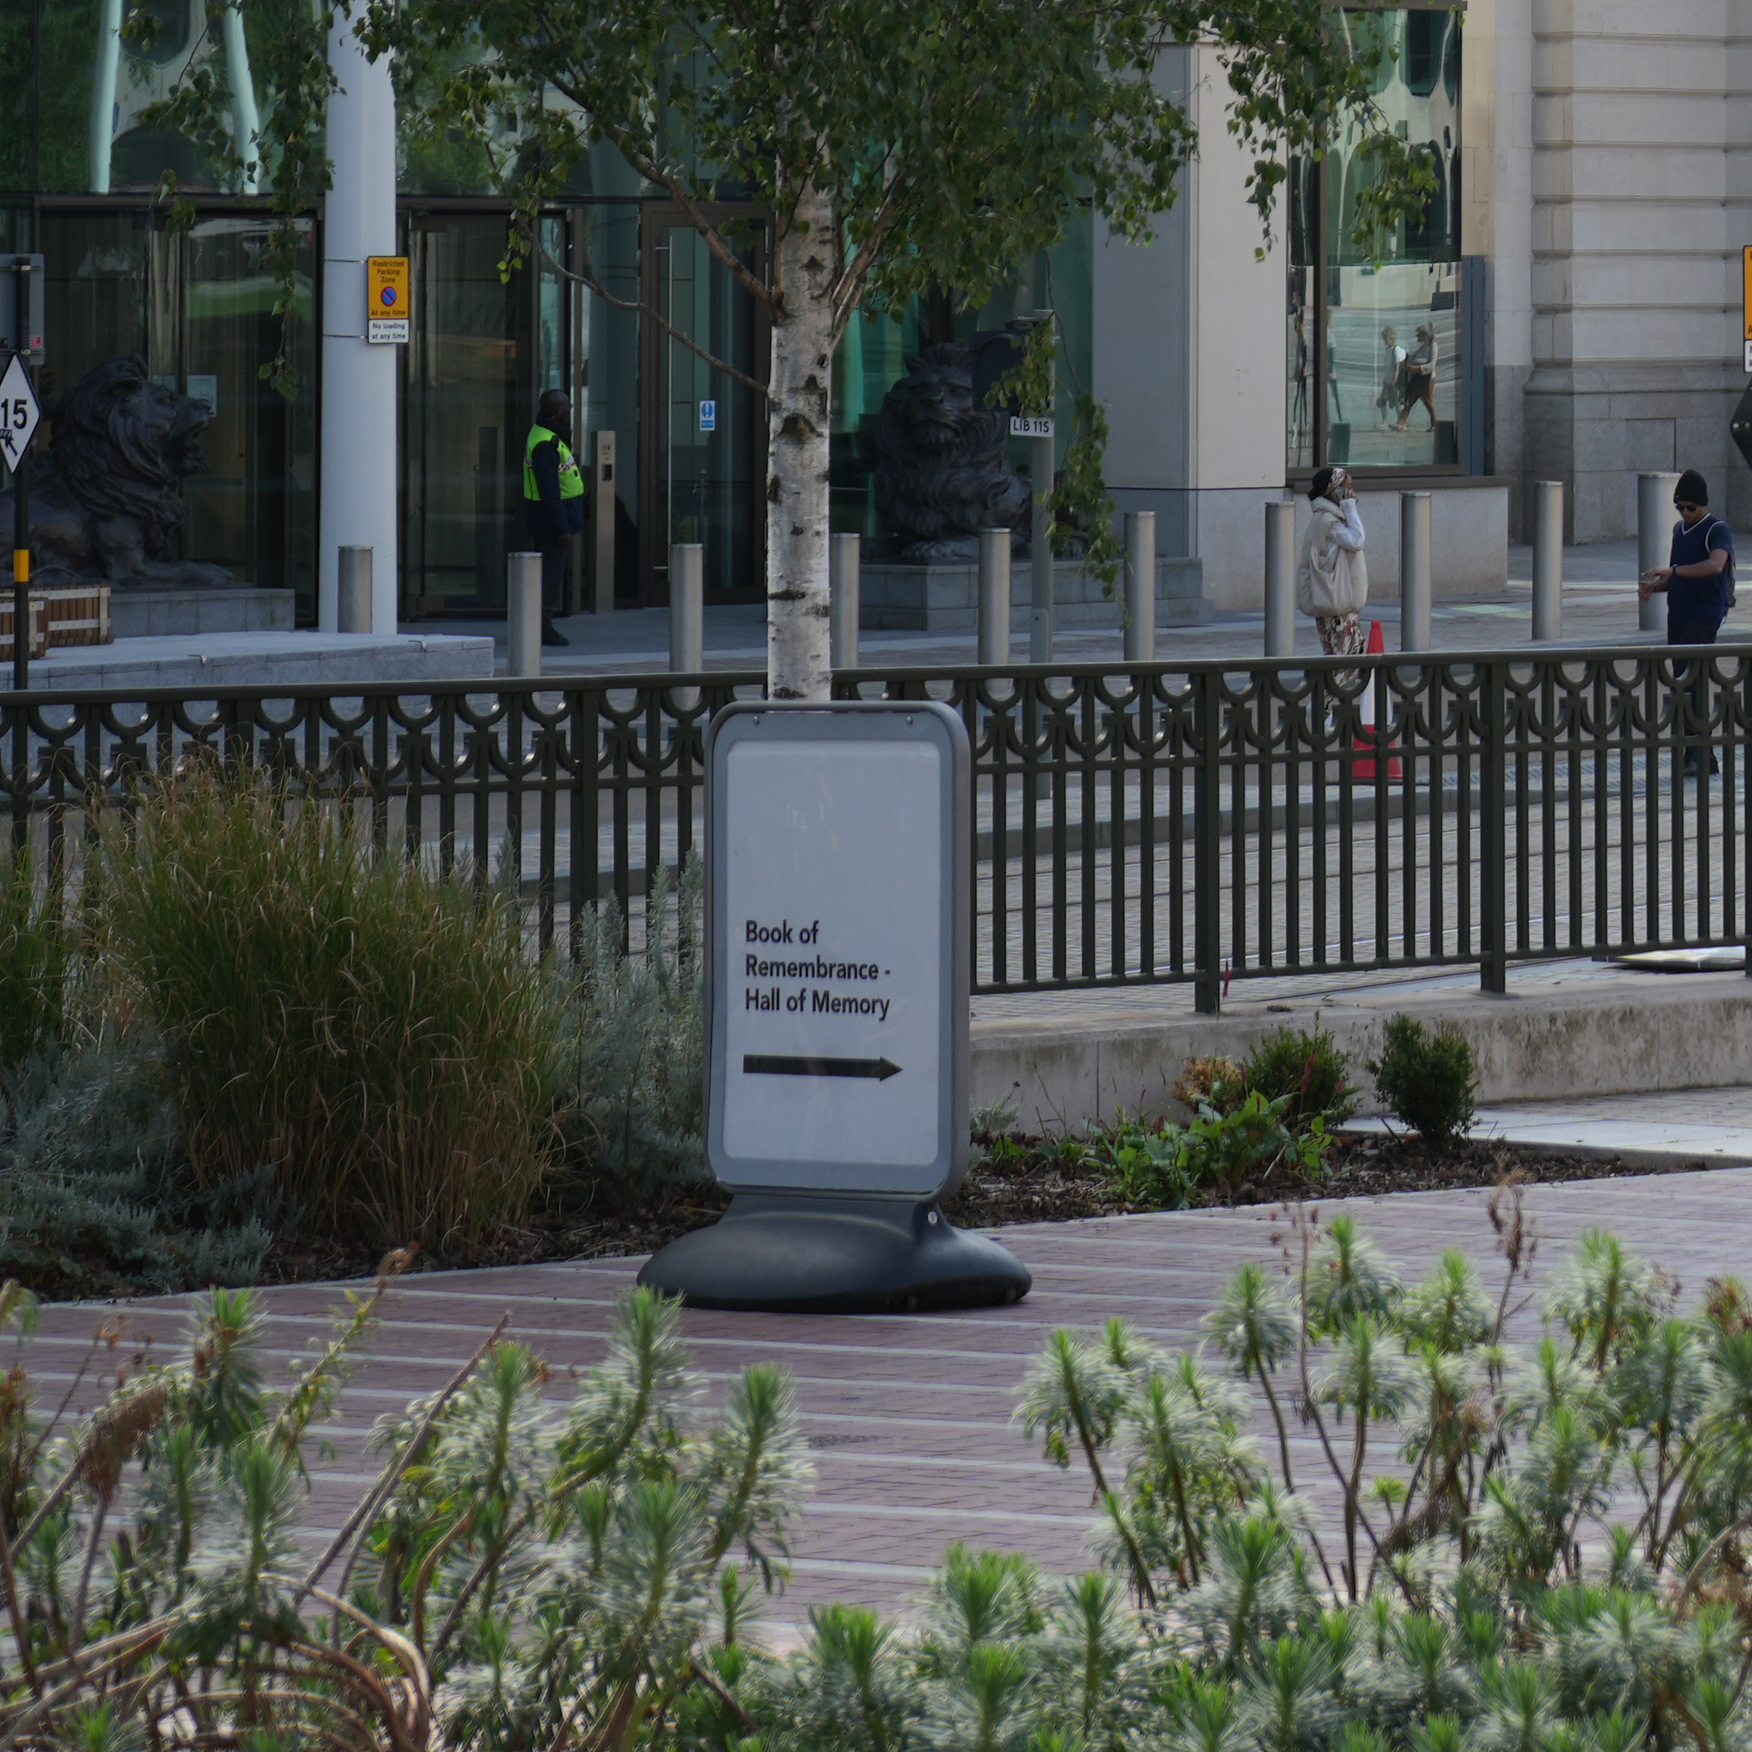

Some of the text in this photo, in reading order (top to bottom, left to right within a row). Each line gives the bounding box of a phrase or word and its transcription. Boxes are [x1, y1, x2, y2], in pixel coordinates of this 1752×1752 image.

[377, 268, 400, 276] Parking
[372, 322, 406, 330] No loading
[0, 398, 28, 430] 15
[1013, 418, 1030, 432] LIB
[745, 919, 819, 944] Book of
[745, 953, 879, 980] Remembrance
[745, 987, 890, 1022] Hall of Memory
